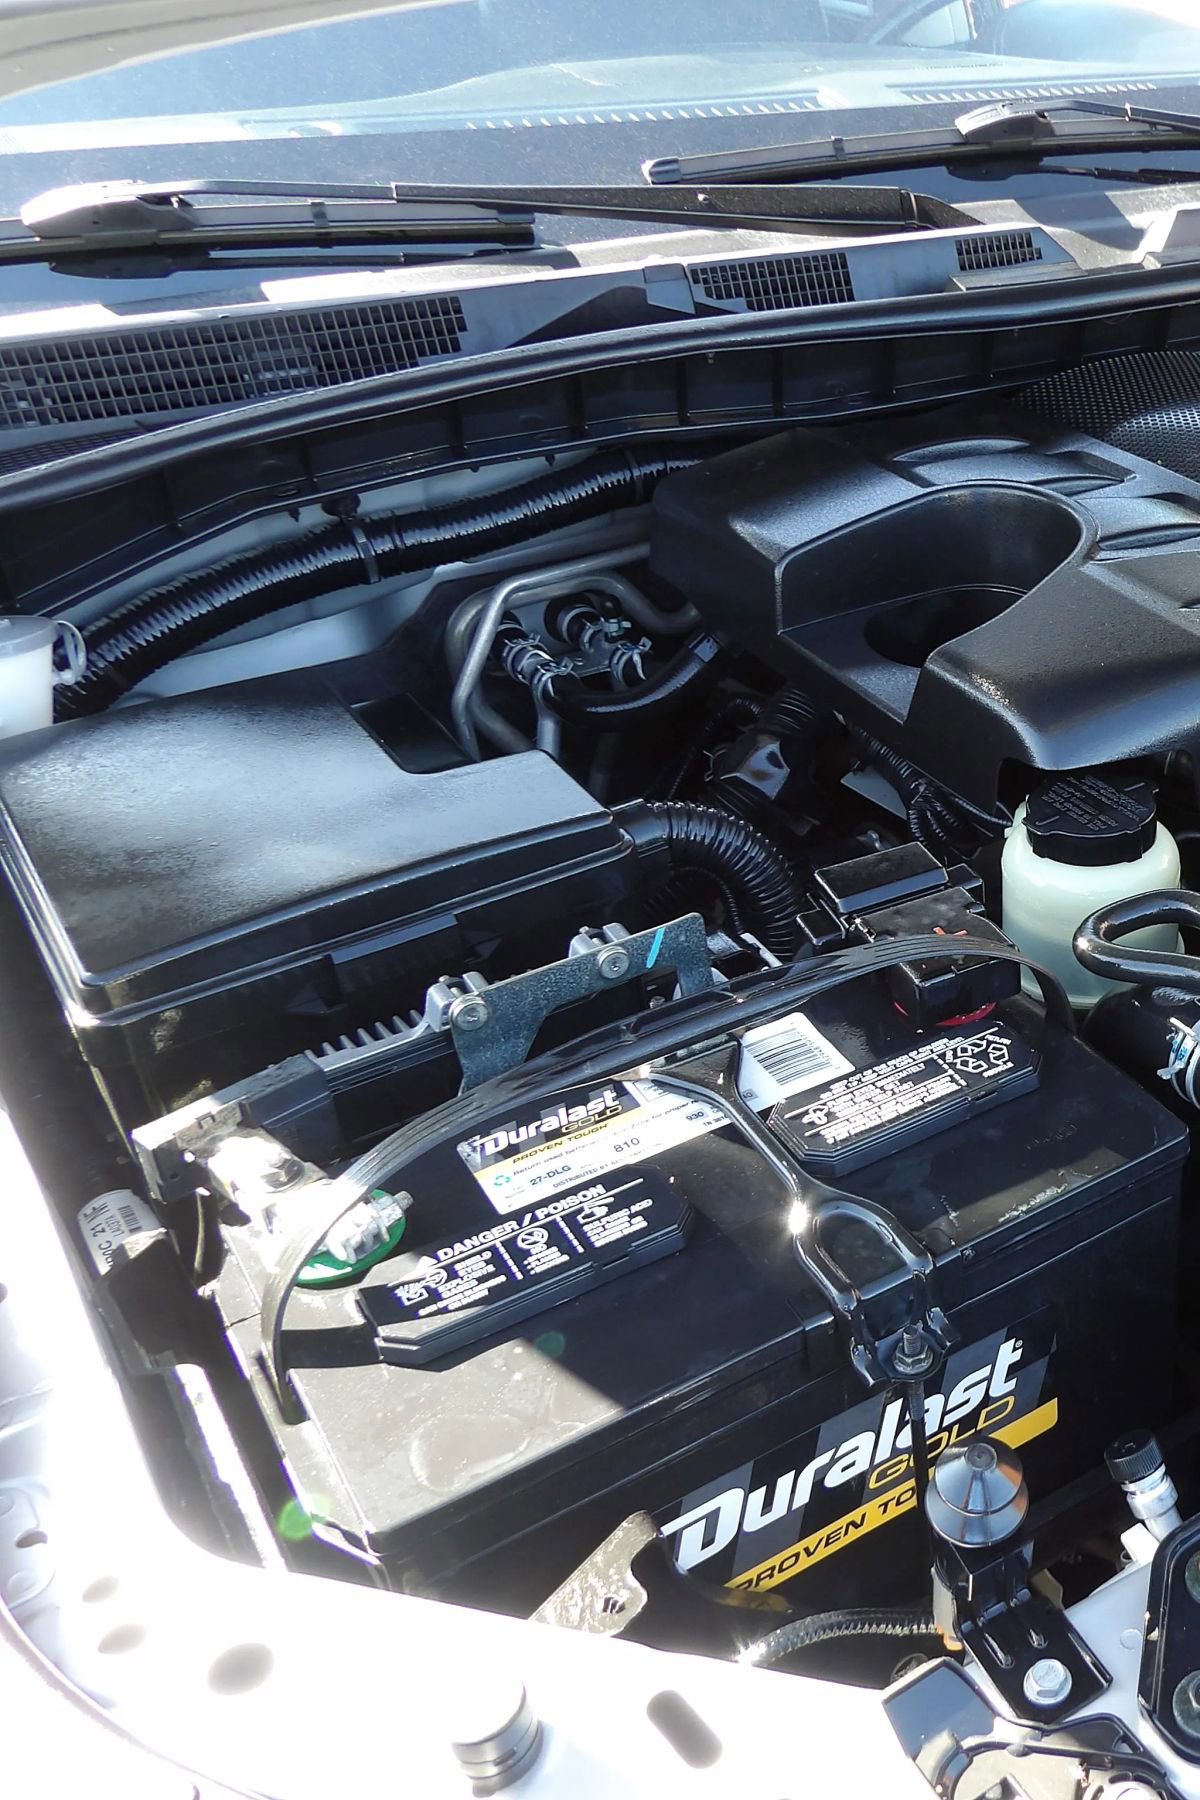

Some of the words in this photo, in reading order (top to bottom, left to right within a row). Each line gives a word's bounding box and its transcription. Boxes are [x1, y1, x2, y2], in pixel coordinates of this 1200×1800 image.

[474, 1089, 620, 1157] Duralast
[561, 1104, 623, 1133] GOLD
[686, 1111, 705, 1121] 930
[512, 1140, 564, 1164] PROVEN
[567, 1122, 609, 1142] TOUGH
[613, 1137, 641, 1153] 810
[530, 1165, 572, 1186] 27-DLG
[553, 1167, 599, 1189] DISTRIBUTED
[91, 1223, 106, 1238] 21
[437, 1219, 521, 1261] DANGER
[535, 1184, 607, 1221] POISON
[661, 1338, 1020, 1570] Duralast
[868, 1396, 1016, 1490] GOLD
[733, 1510, 871, 1593] PROVEN
